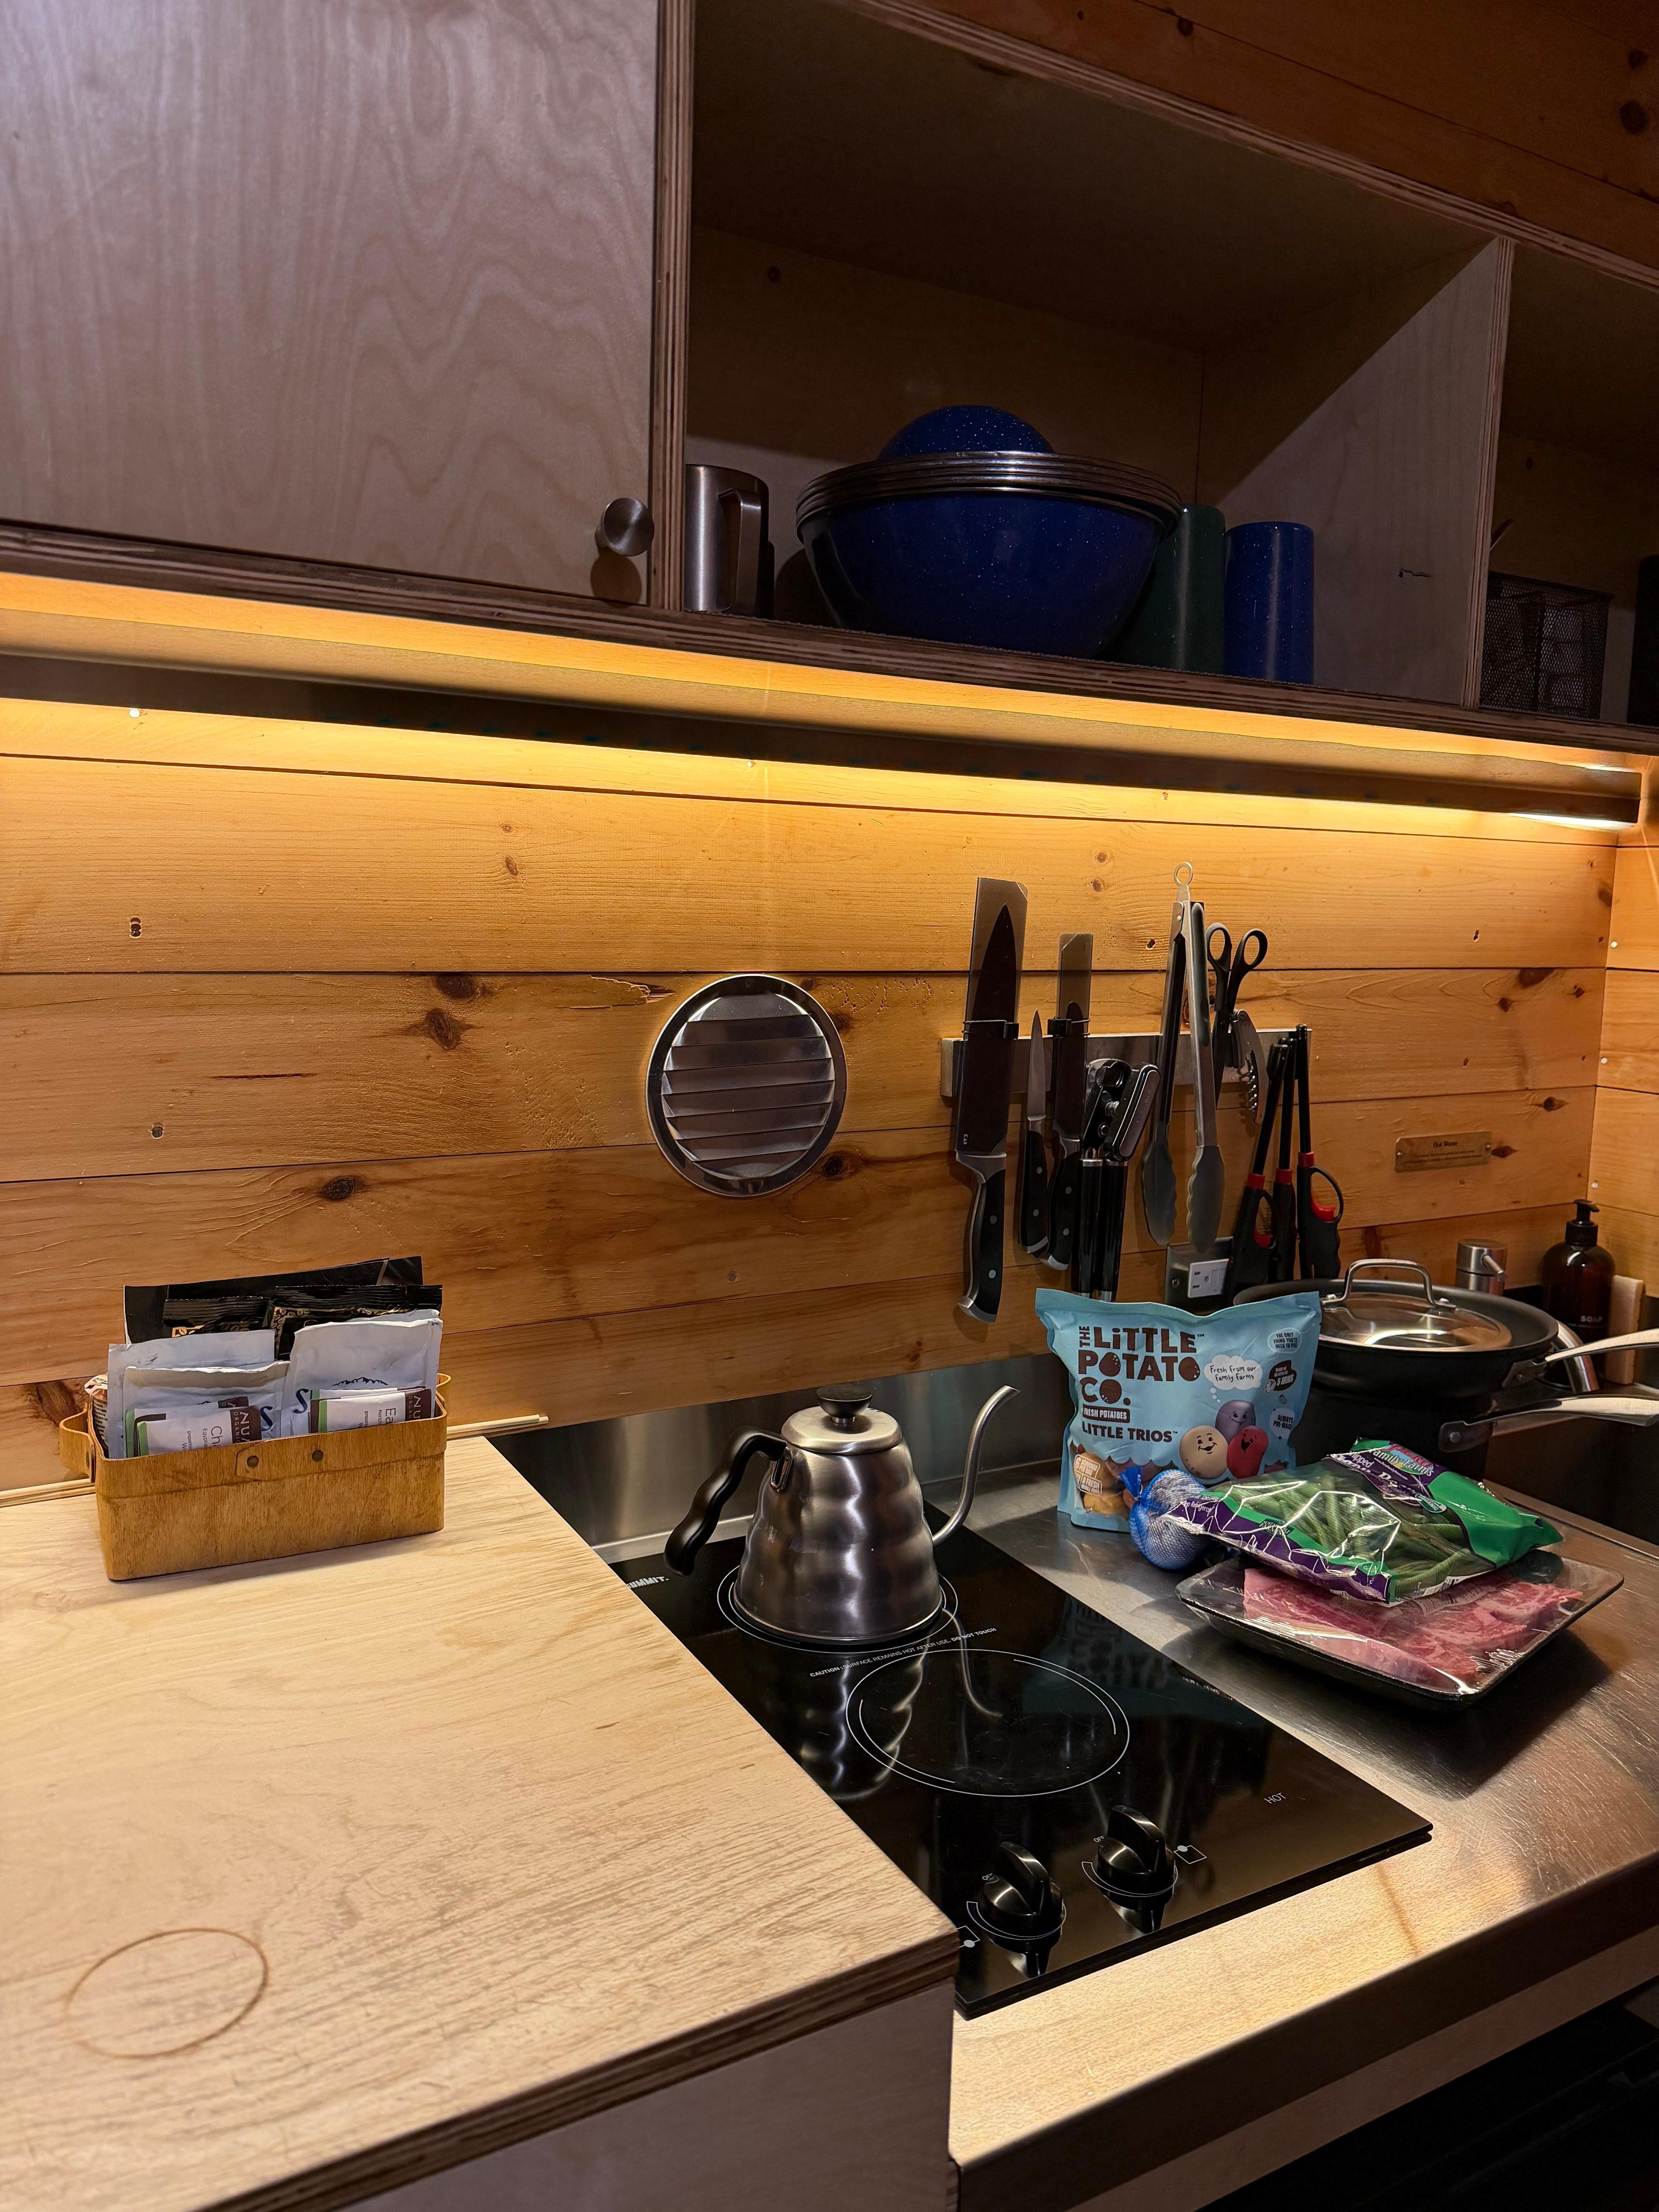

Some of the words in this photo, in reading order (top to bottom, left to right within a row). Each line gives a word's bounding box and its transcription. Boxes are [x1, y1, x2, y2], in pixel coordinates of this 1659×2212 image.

[1079, 1326, 1091, 1348] THE
[1078, 1349, 1200, 1381] POTATO
[1210, 1365, 1227, 1373] Fresh
[1215, 1374, 1233, 1382] family
[1079, 1377, 1131, 1406] CO.
[1084, 1408, 1098, 1417] FRESH
[1099, 1410, 1127, 1420] POTATOES
[1082, 1421, 1123, 1439] LITTLE
[1273, 1420, 1292, 1430] PRE-WAS
[211, 1426, 223, 1447] Ch
[842, 1658, 873, 1669] SURFACE
[872, 1651, 902, 1662] REMAINS
[916, 1642, 937, 1650] AFTER
[974, 1628, 997, 1636] TOUCH
[1264, 1792, 1286, 1804] HOT
